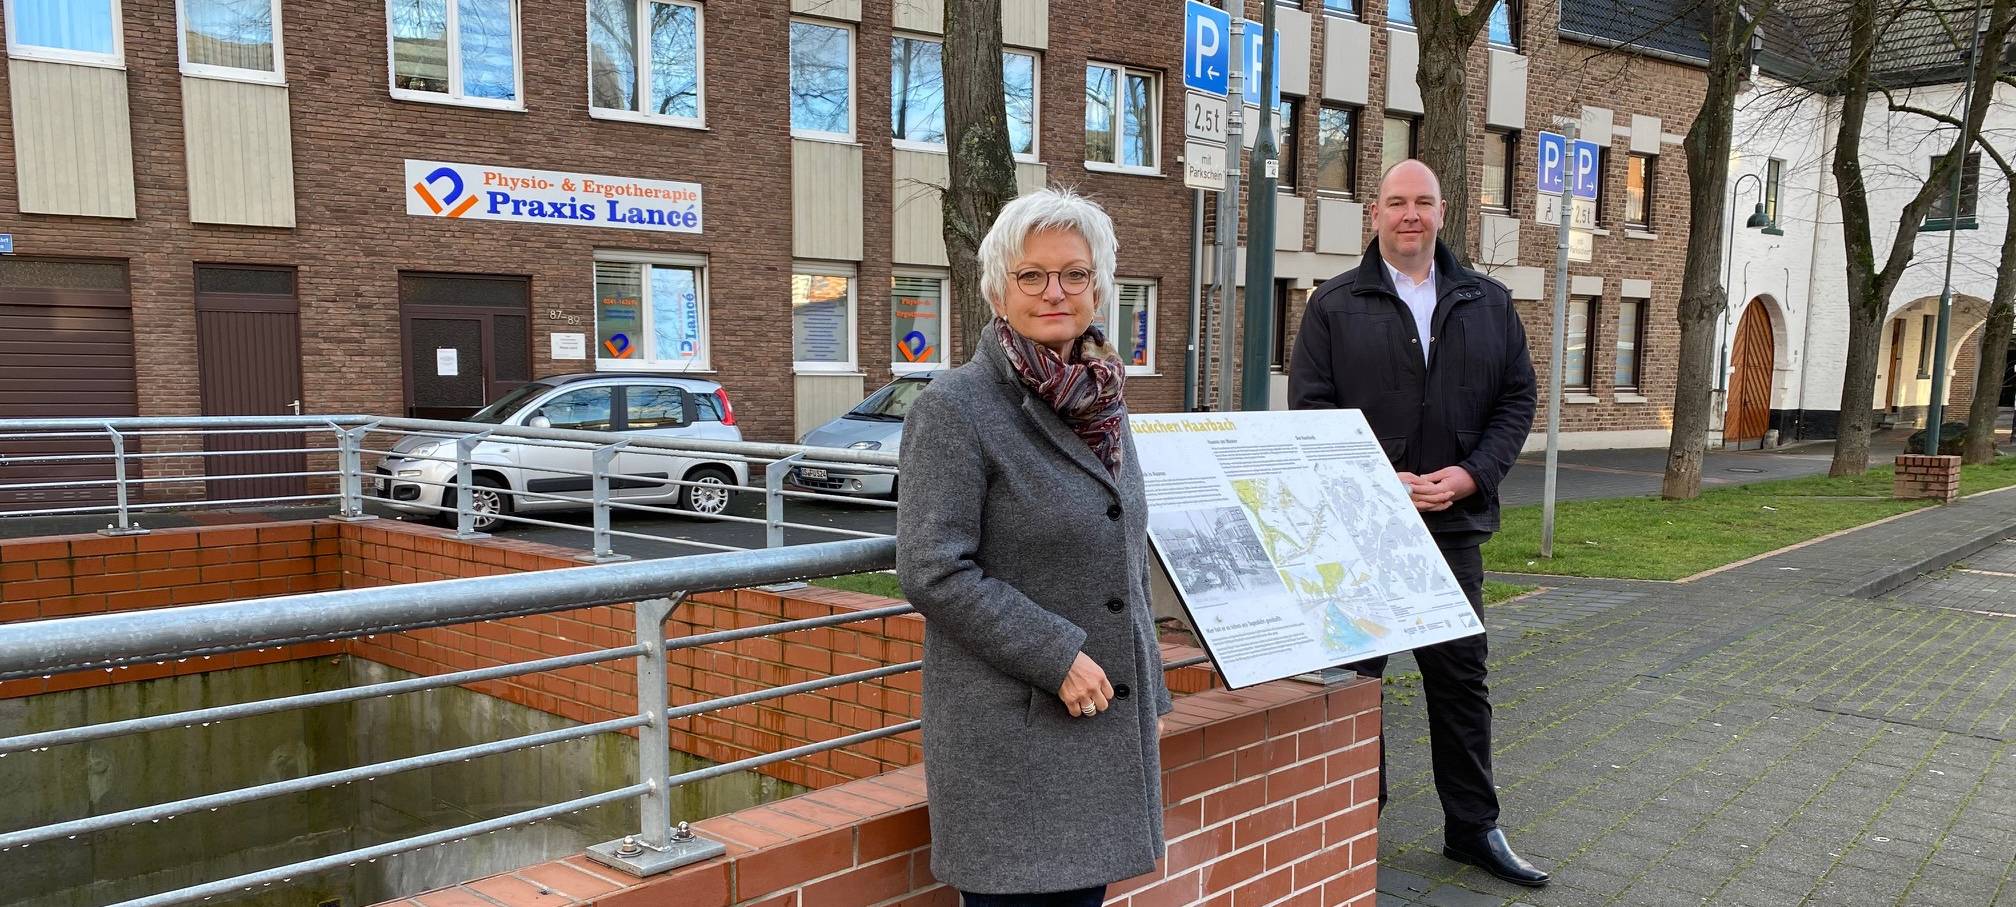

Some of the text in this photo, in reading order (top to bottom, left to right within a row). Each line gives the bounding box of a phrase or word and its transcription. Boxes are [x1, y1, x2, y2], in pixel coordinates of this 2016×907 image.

[1195, 15, 1220, 78] P
[1189, 166, 1223, 181] Parkschein
[1201, 154, 1212, 166] mit
[1544, 141, 1560, 184] P
[1578, 148, 1592, 190] P
[483, 171, 697, 203] Physio- & Ergotherapie
[486, 190, 697, 228] Praxis Lancé
[682, 293, 697, 339] Lancé
[1183, 417, 1237, 433] Haarbach
